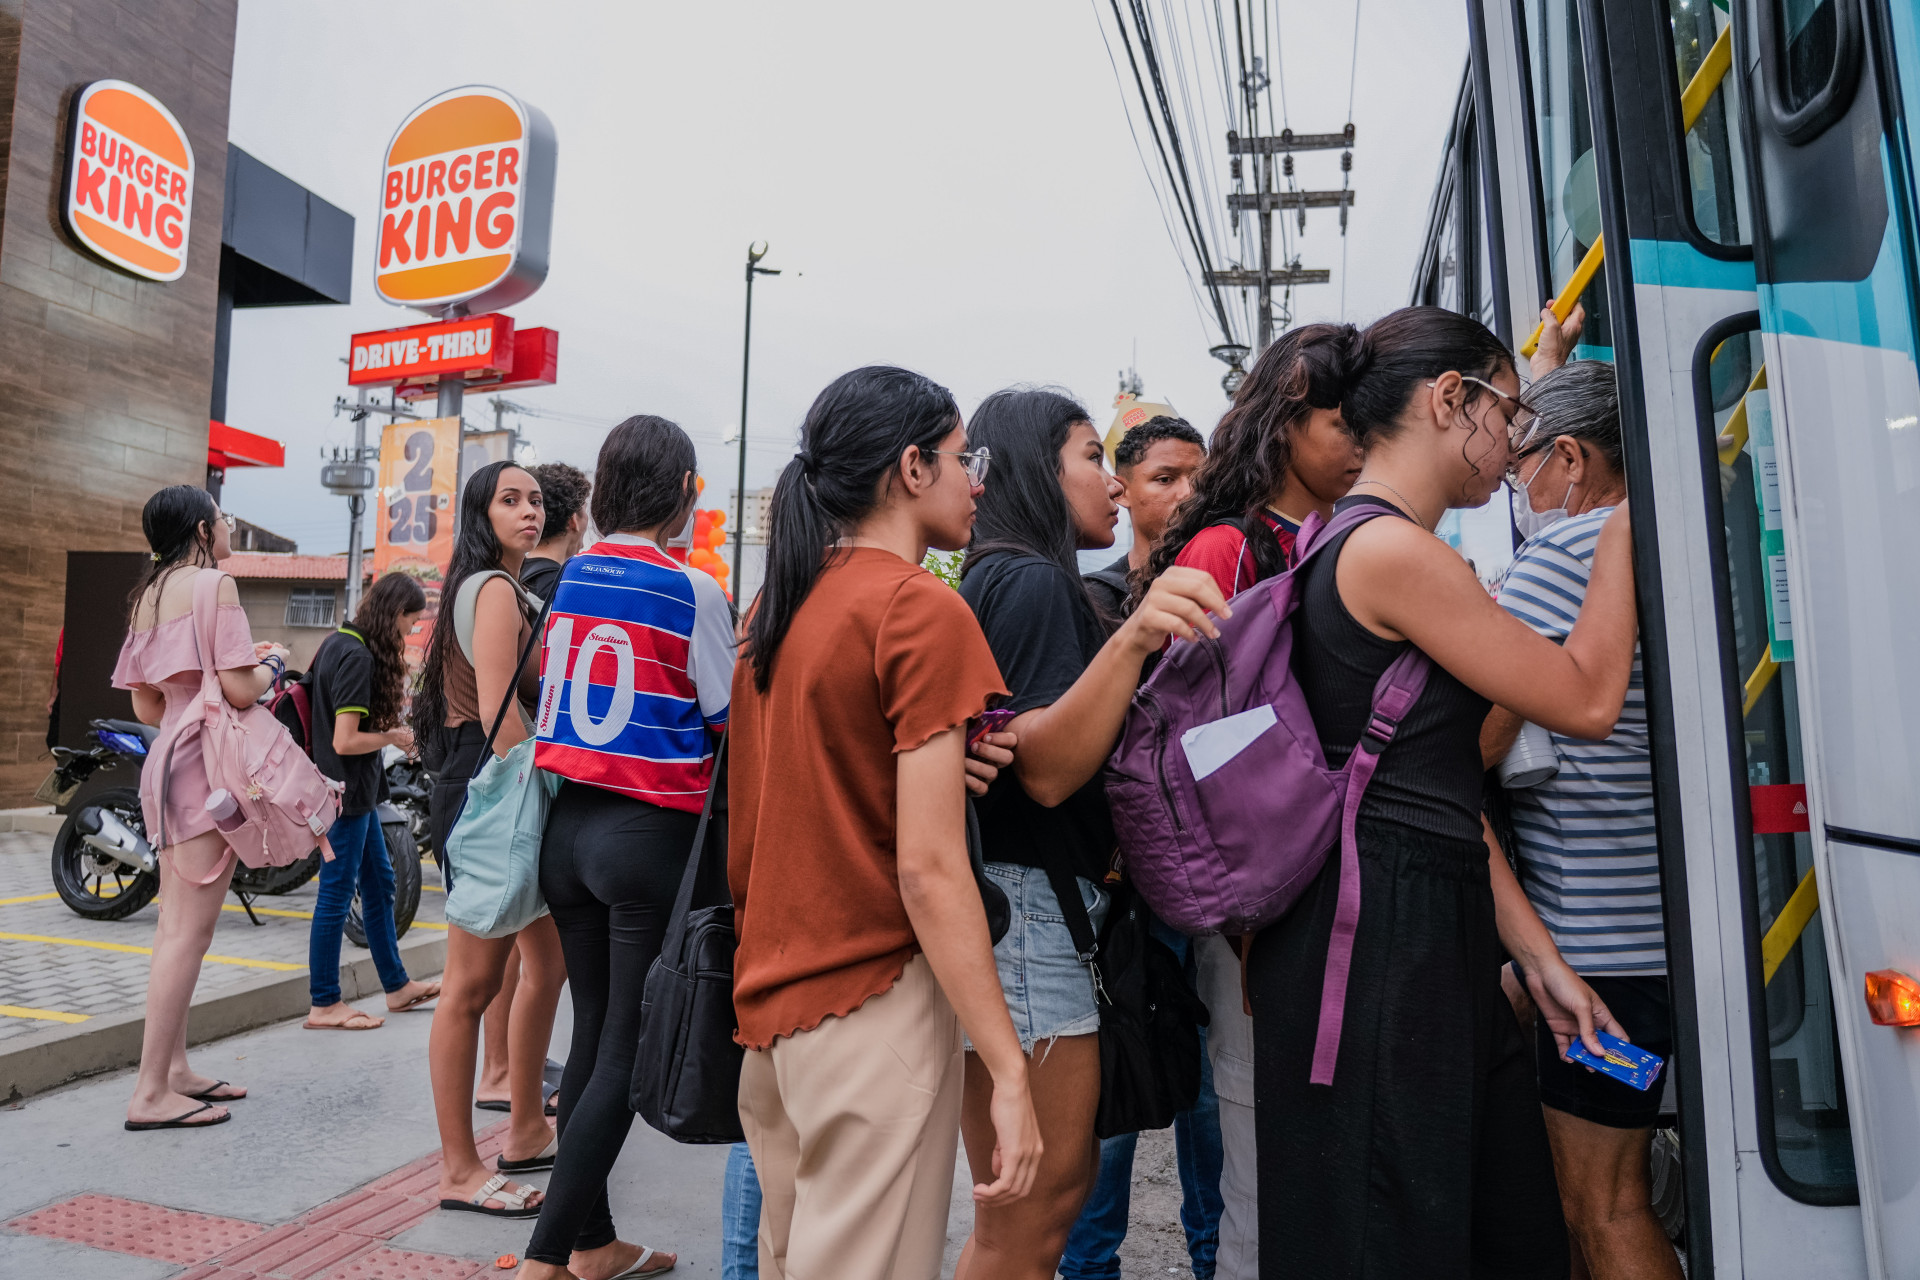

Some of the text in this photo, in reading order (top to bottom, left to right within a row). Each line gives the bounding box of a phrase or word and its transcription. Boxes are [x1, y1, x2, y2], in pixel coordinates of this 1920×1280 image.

[81, 121, 187, 207] BURGER
[385, 147, 519, 210] BURGER
[76, 157, 184, 250] KING
[379, 191, 516, 269] KING
[352, 328, 492, 371] DRIVE-THRU
[404, 431, 434, 492] 2
[388, 495, 438, 544] 25
[588, 632, 630, 647] Stadium
[536, 616, 635, 746] 10
[539, 683, 556, 733] Stadium
